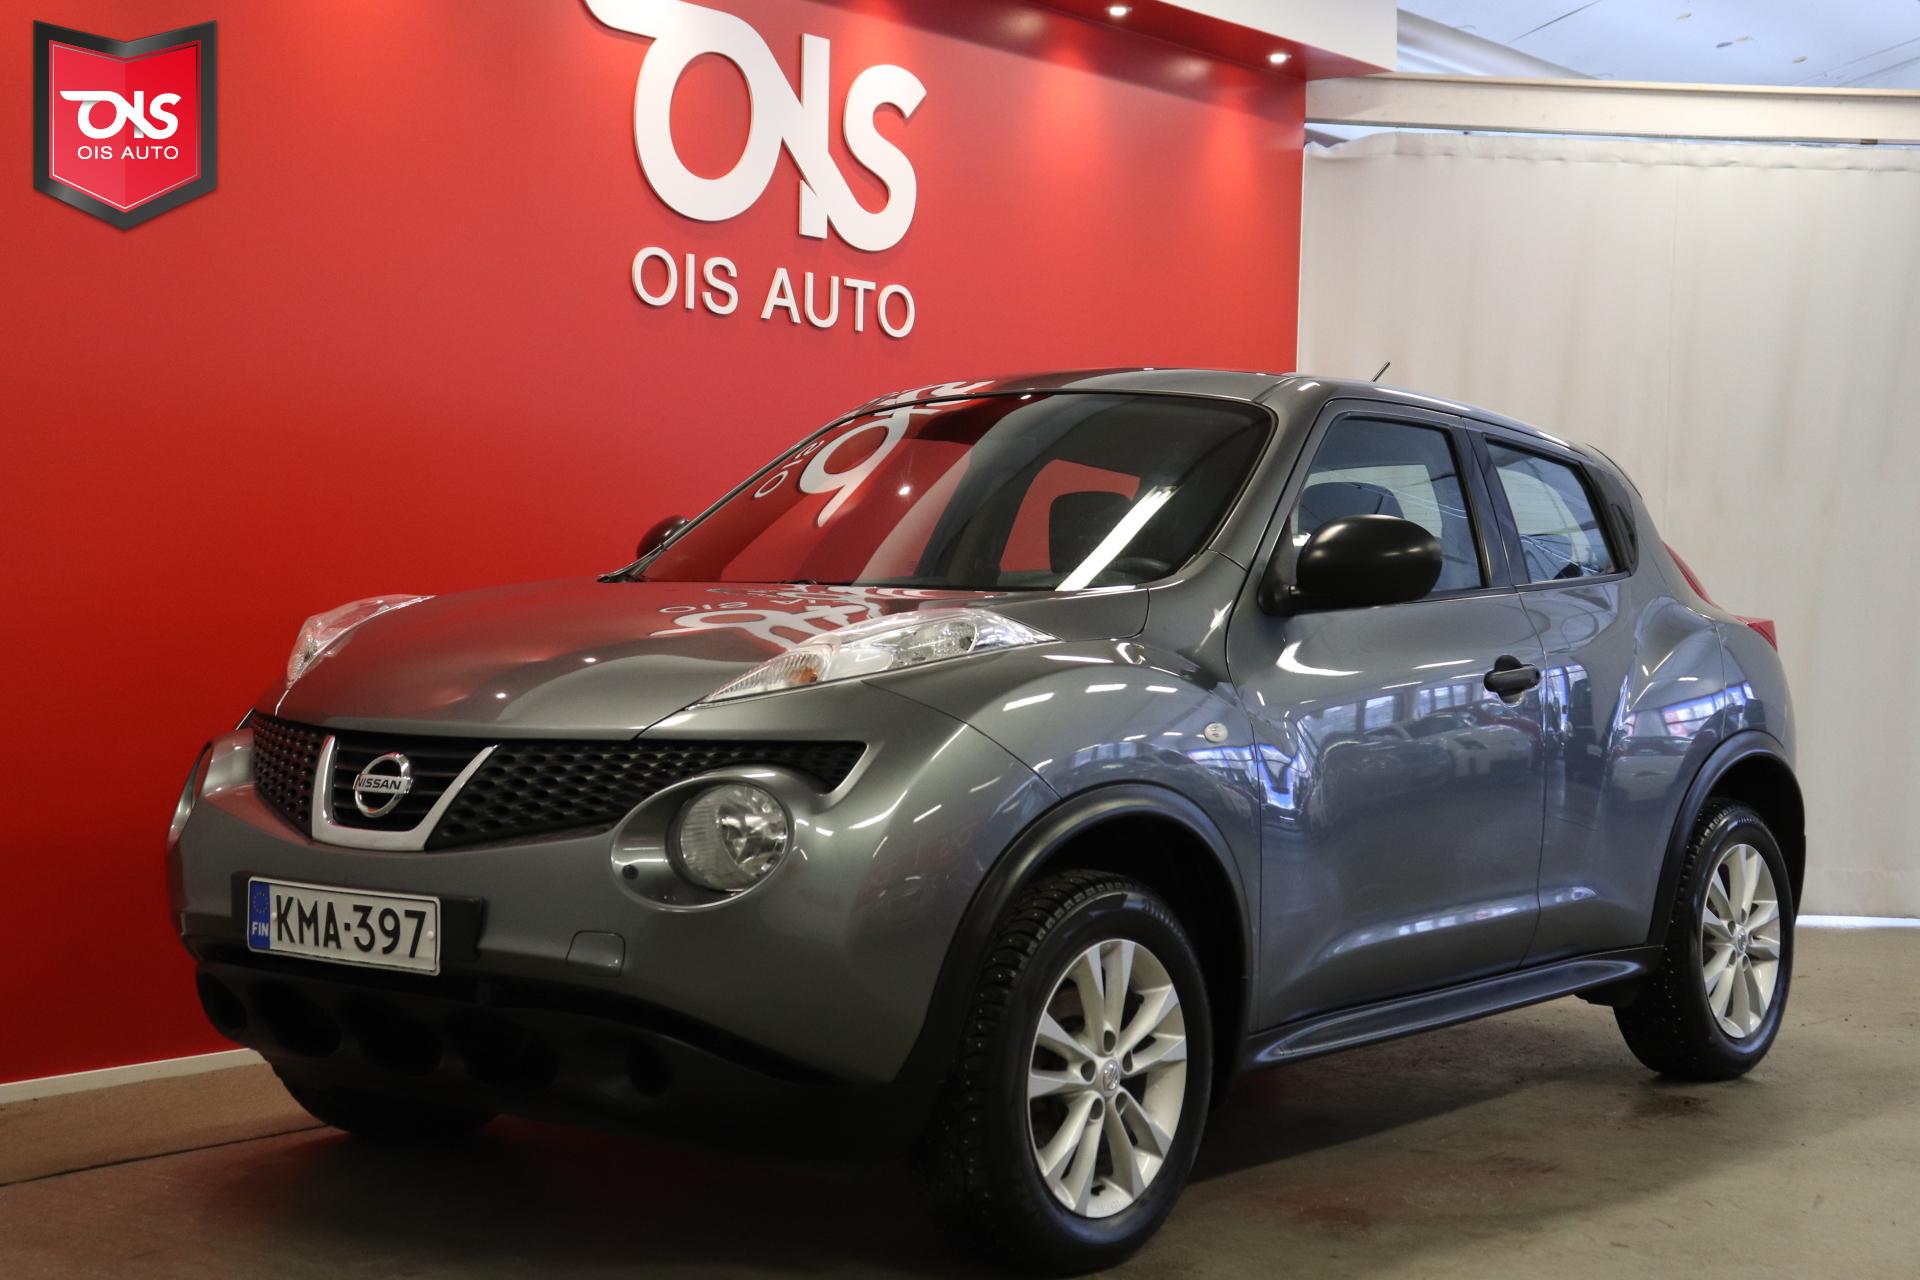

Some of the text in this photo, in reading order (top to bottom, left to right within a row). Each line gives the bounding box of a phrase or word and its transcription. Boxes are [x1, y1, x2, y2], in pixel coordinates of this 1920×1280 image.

[583, 0, 926, 251] OIS
[632, 247, 915, 338] OIS AUTO
[355, 777, 402, 790] NISSAN
[252, 895, 427, 958] FIN KMA-397
